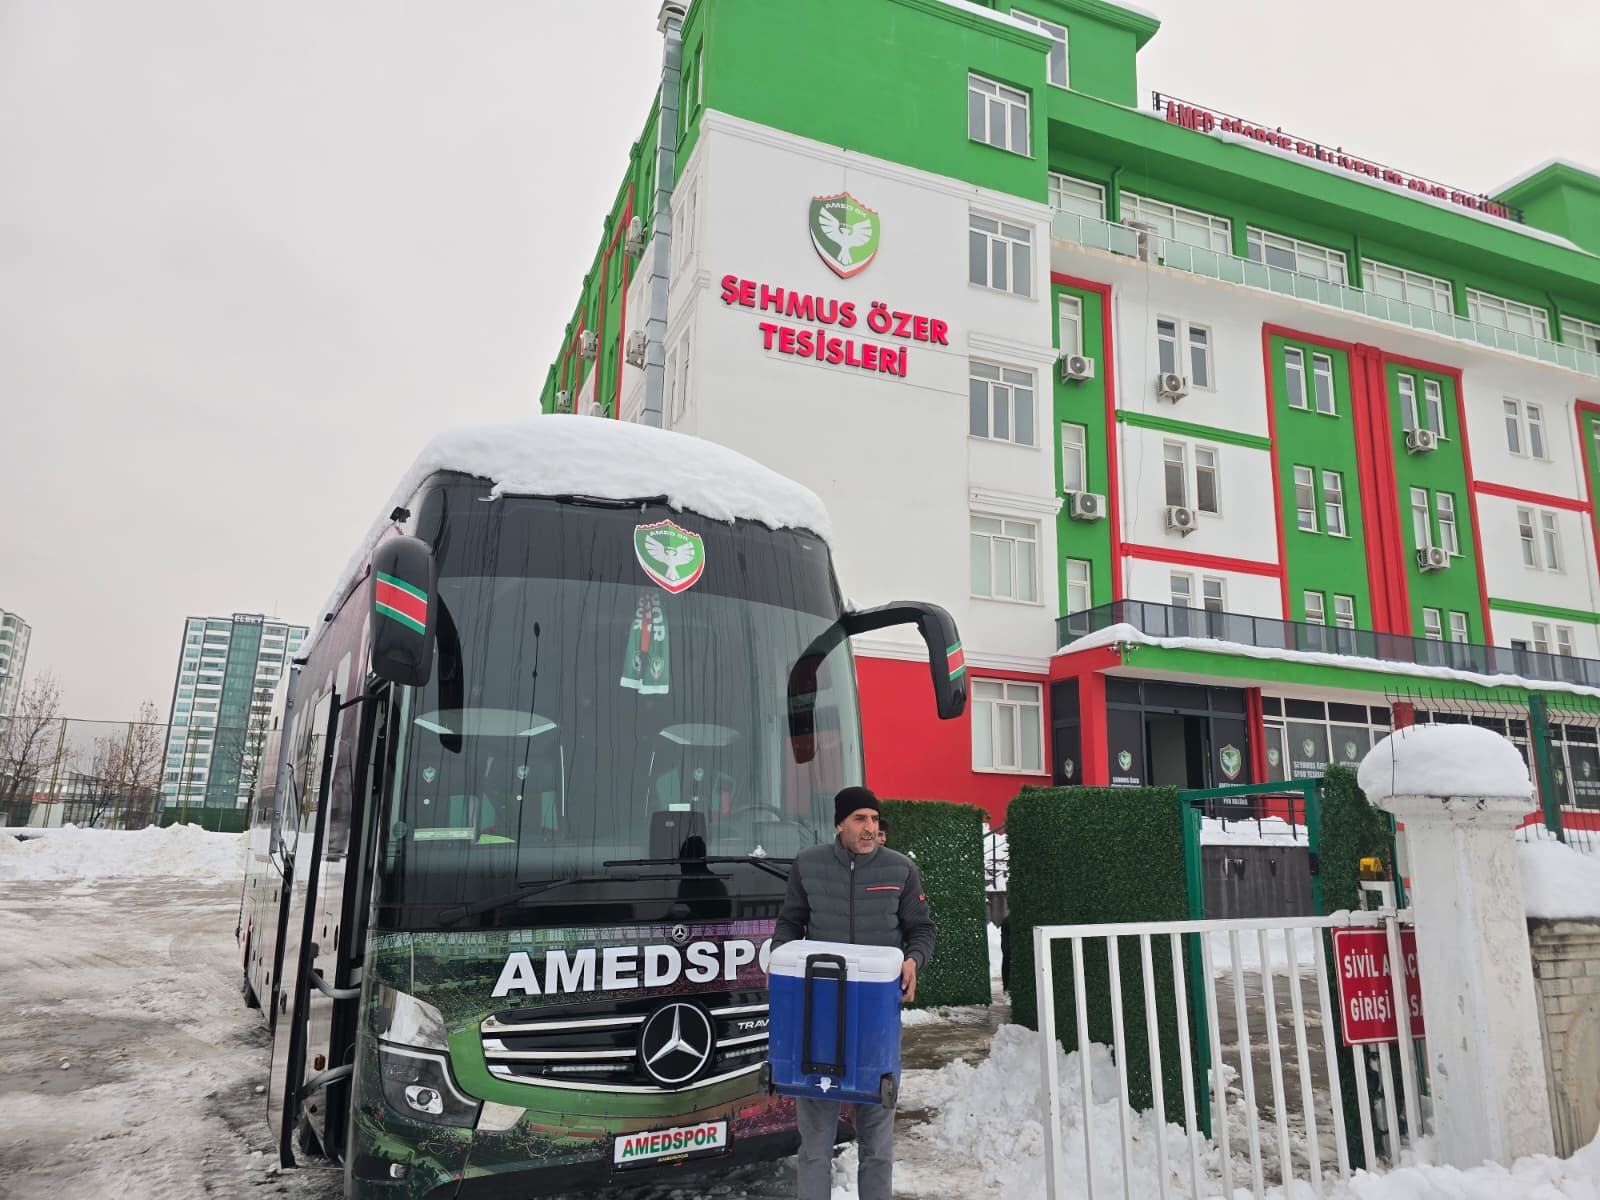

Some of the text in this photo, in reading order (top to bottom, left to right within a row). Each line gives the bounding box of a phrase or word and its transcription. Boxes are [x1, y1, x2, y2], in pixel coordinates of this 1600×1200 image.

[1166, 100, 1215, 134] AMED
[721, 274, 949, 346] ŞEHMUS ÖZER
[759, 322, 907, 378] TESİSLERİ
[1344, 947, 1380, 979] SİVİL
[1350, 988, 1392, 1023] GİRİŞİ
[622, 1126, 718, 1158] AMEDSPOR
